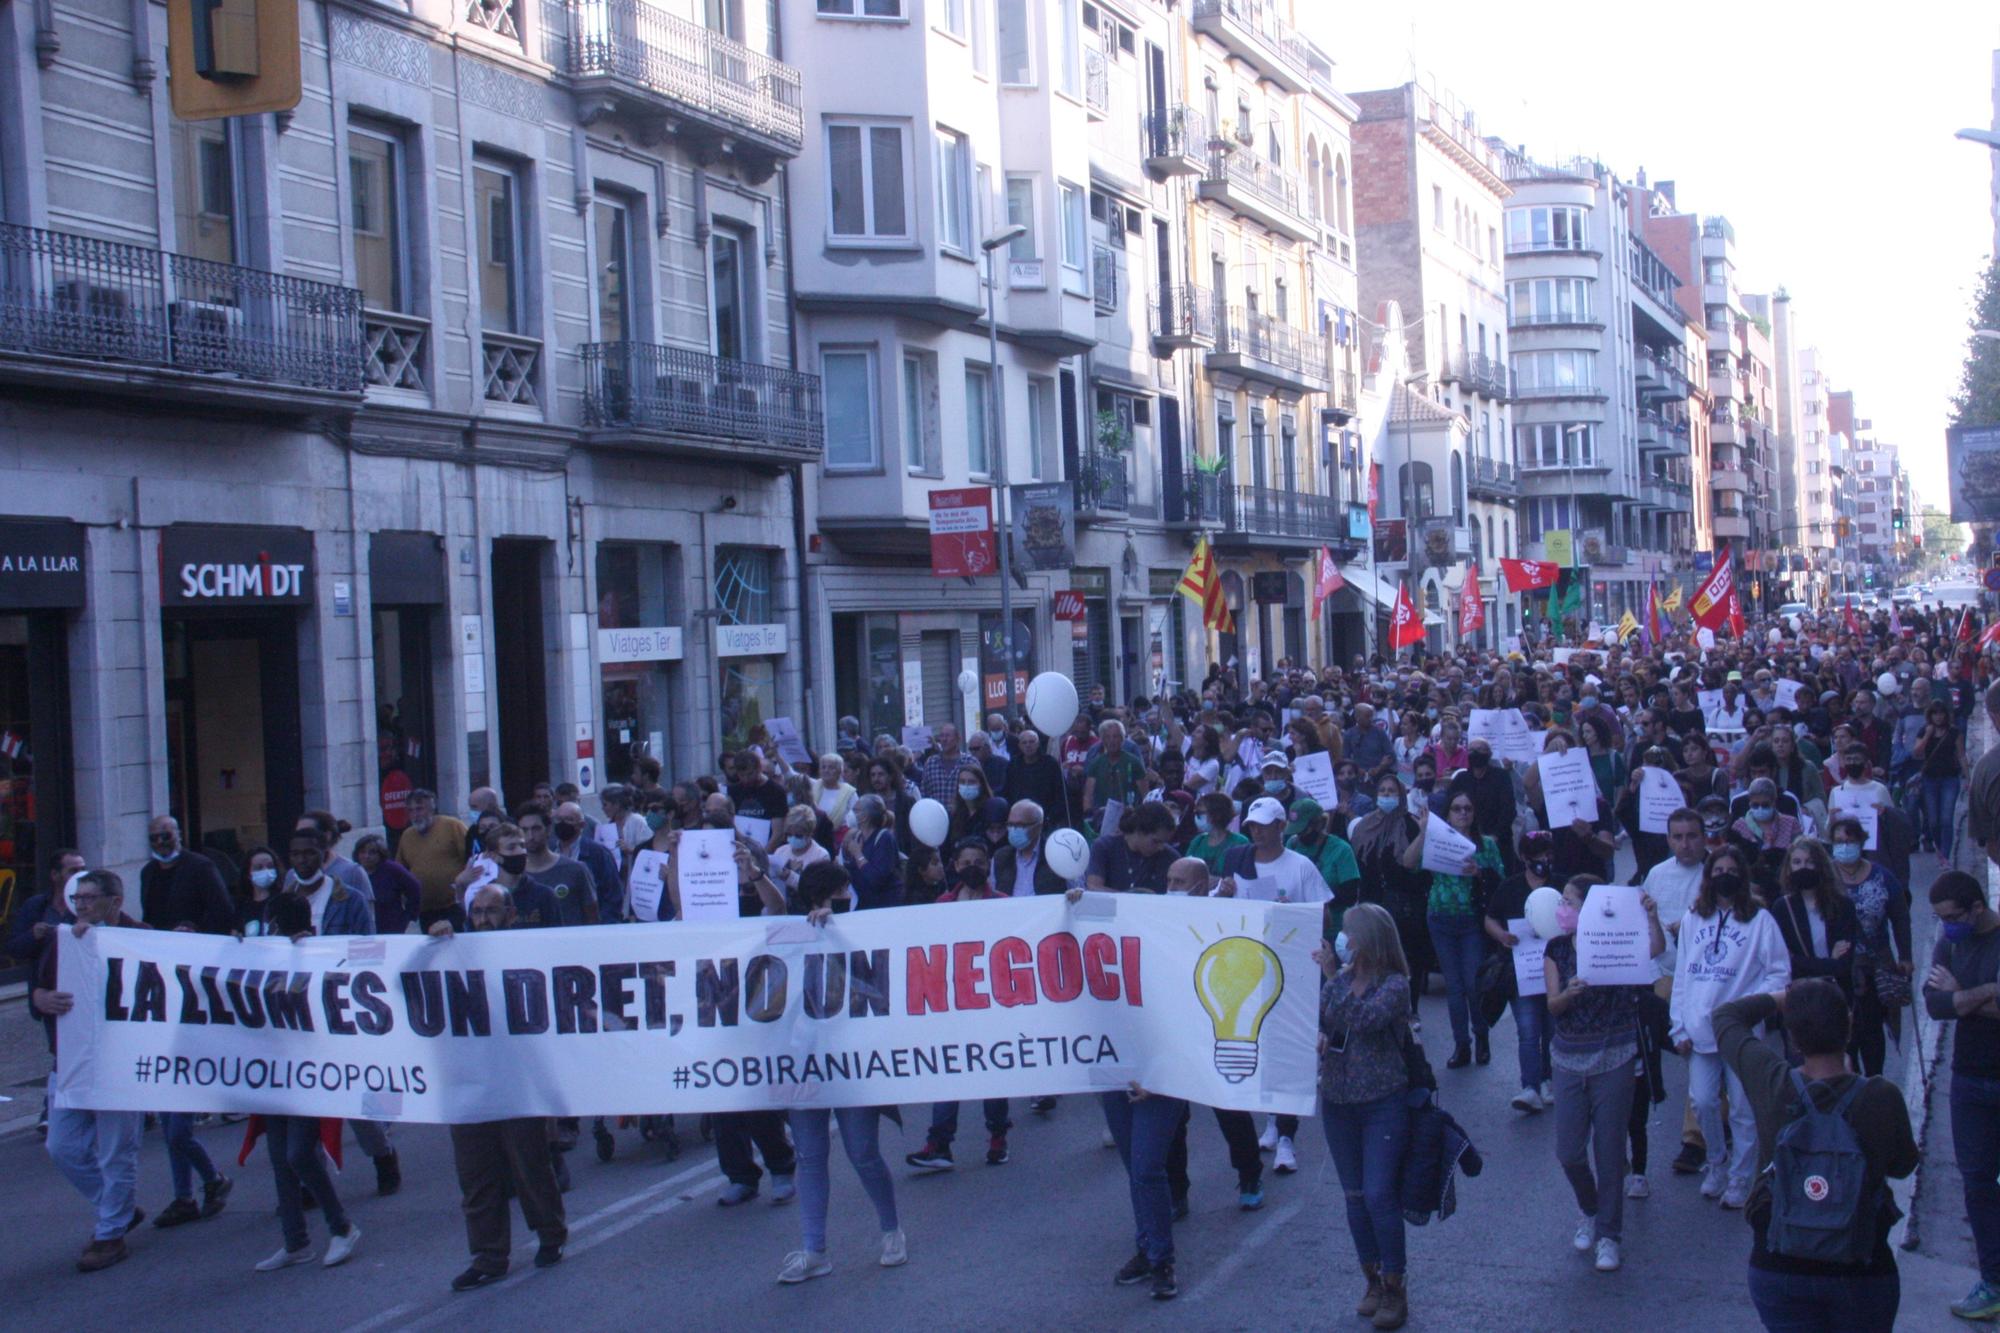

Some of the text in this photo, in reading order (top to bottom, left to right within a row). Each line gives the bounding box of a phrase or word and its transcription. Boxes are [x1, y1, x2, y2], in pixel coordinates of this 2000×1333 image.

[19, 556, 37, 572] LA
[43, 556, 79, 572] LLAR
[1056, 595, 1082, 618] illy
[609, 632, 671, 658] Viatges Ter
[725, 628, 776, 651] Viatges Ter
[1694, 925, 1747, 947] OFFCIAL
[105, 932, 1143, 1038] LA LLUM ÉS UN DRET, NO UN NEGOCI
[673, 1032, 1120, 1090] #SOBIRANIAENERGÈTICA
[135, 1054, 428, 1095] #PROUOLIGOPOLIS
